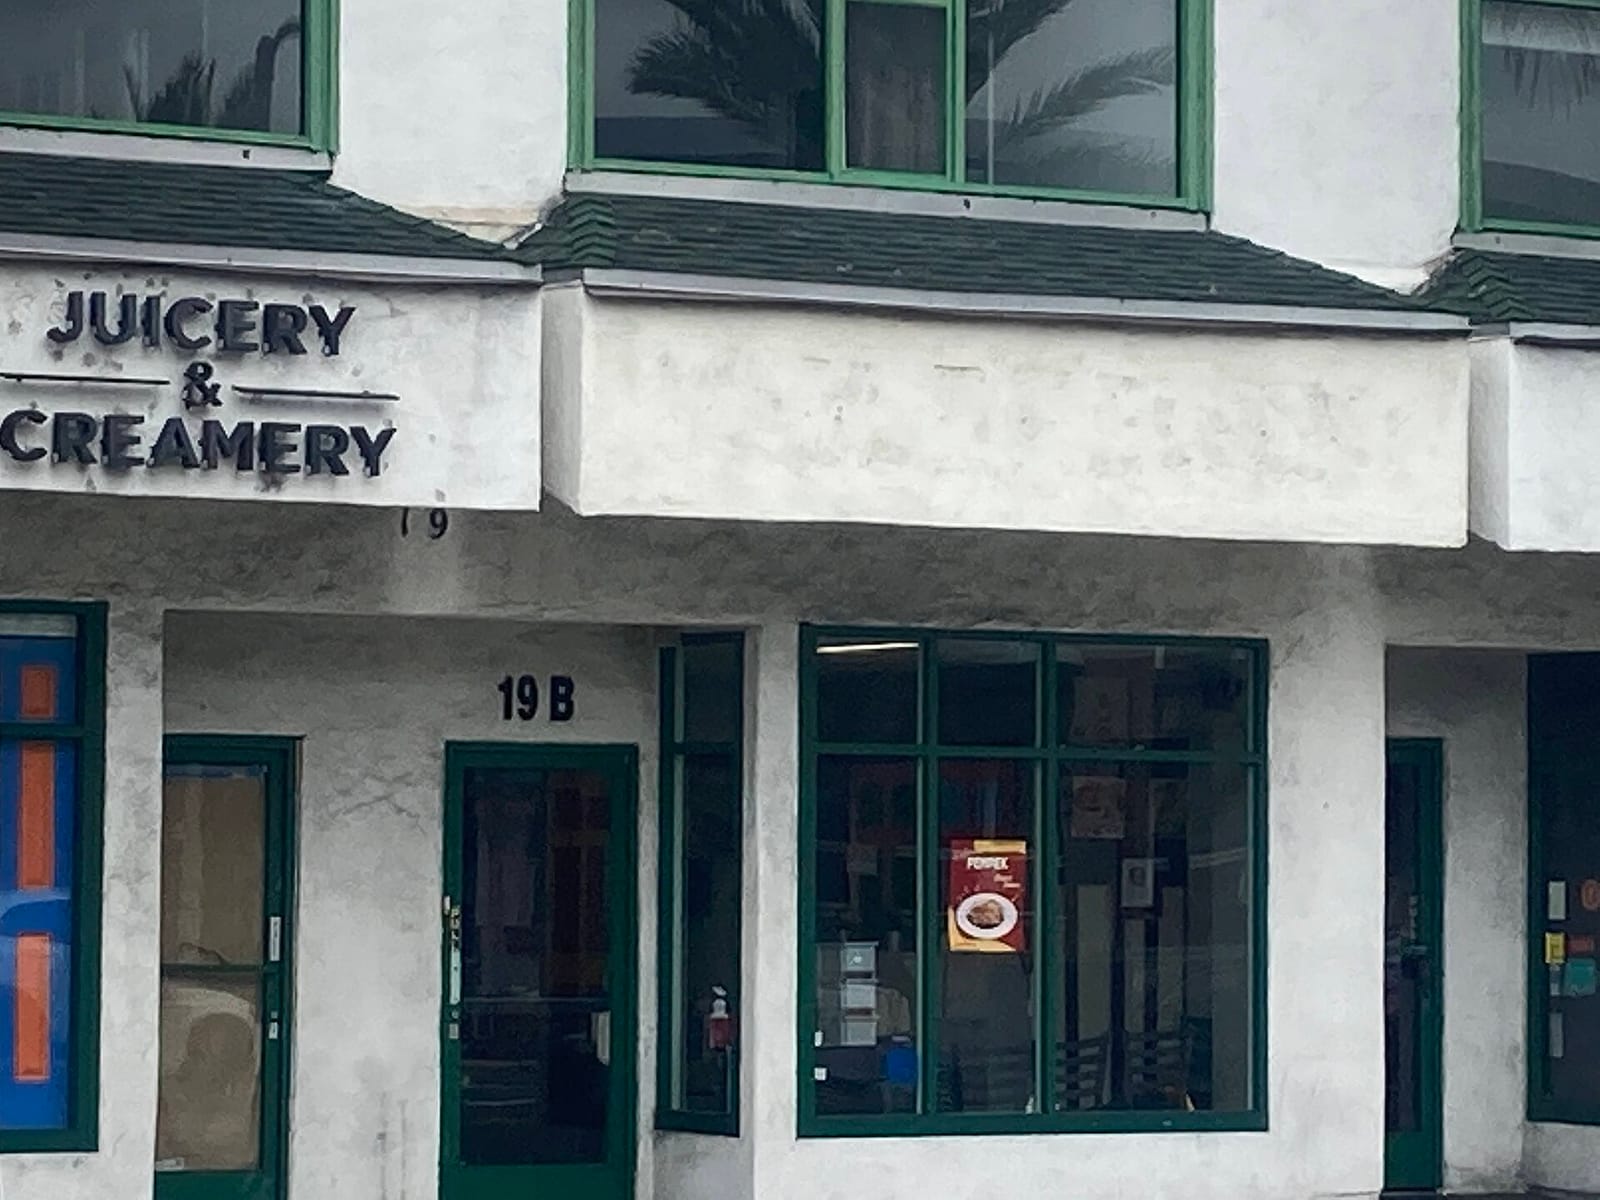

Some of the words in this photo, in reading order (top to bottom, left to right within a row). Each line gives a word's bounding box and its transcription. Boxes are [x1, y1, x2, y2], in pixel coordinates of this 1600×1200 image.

[47, 291, 355, 357] JUICERY
[182, 361, 223, 408] &
[0, 410, 397, 477] CREAMERY
[497, 674, 538, 721] 19
[550, 675, 575, 721] B
